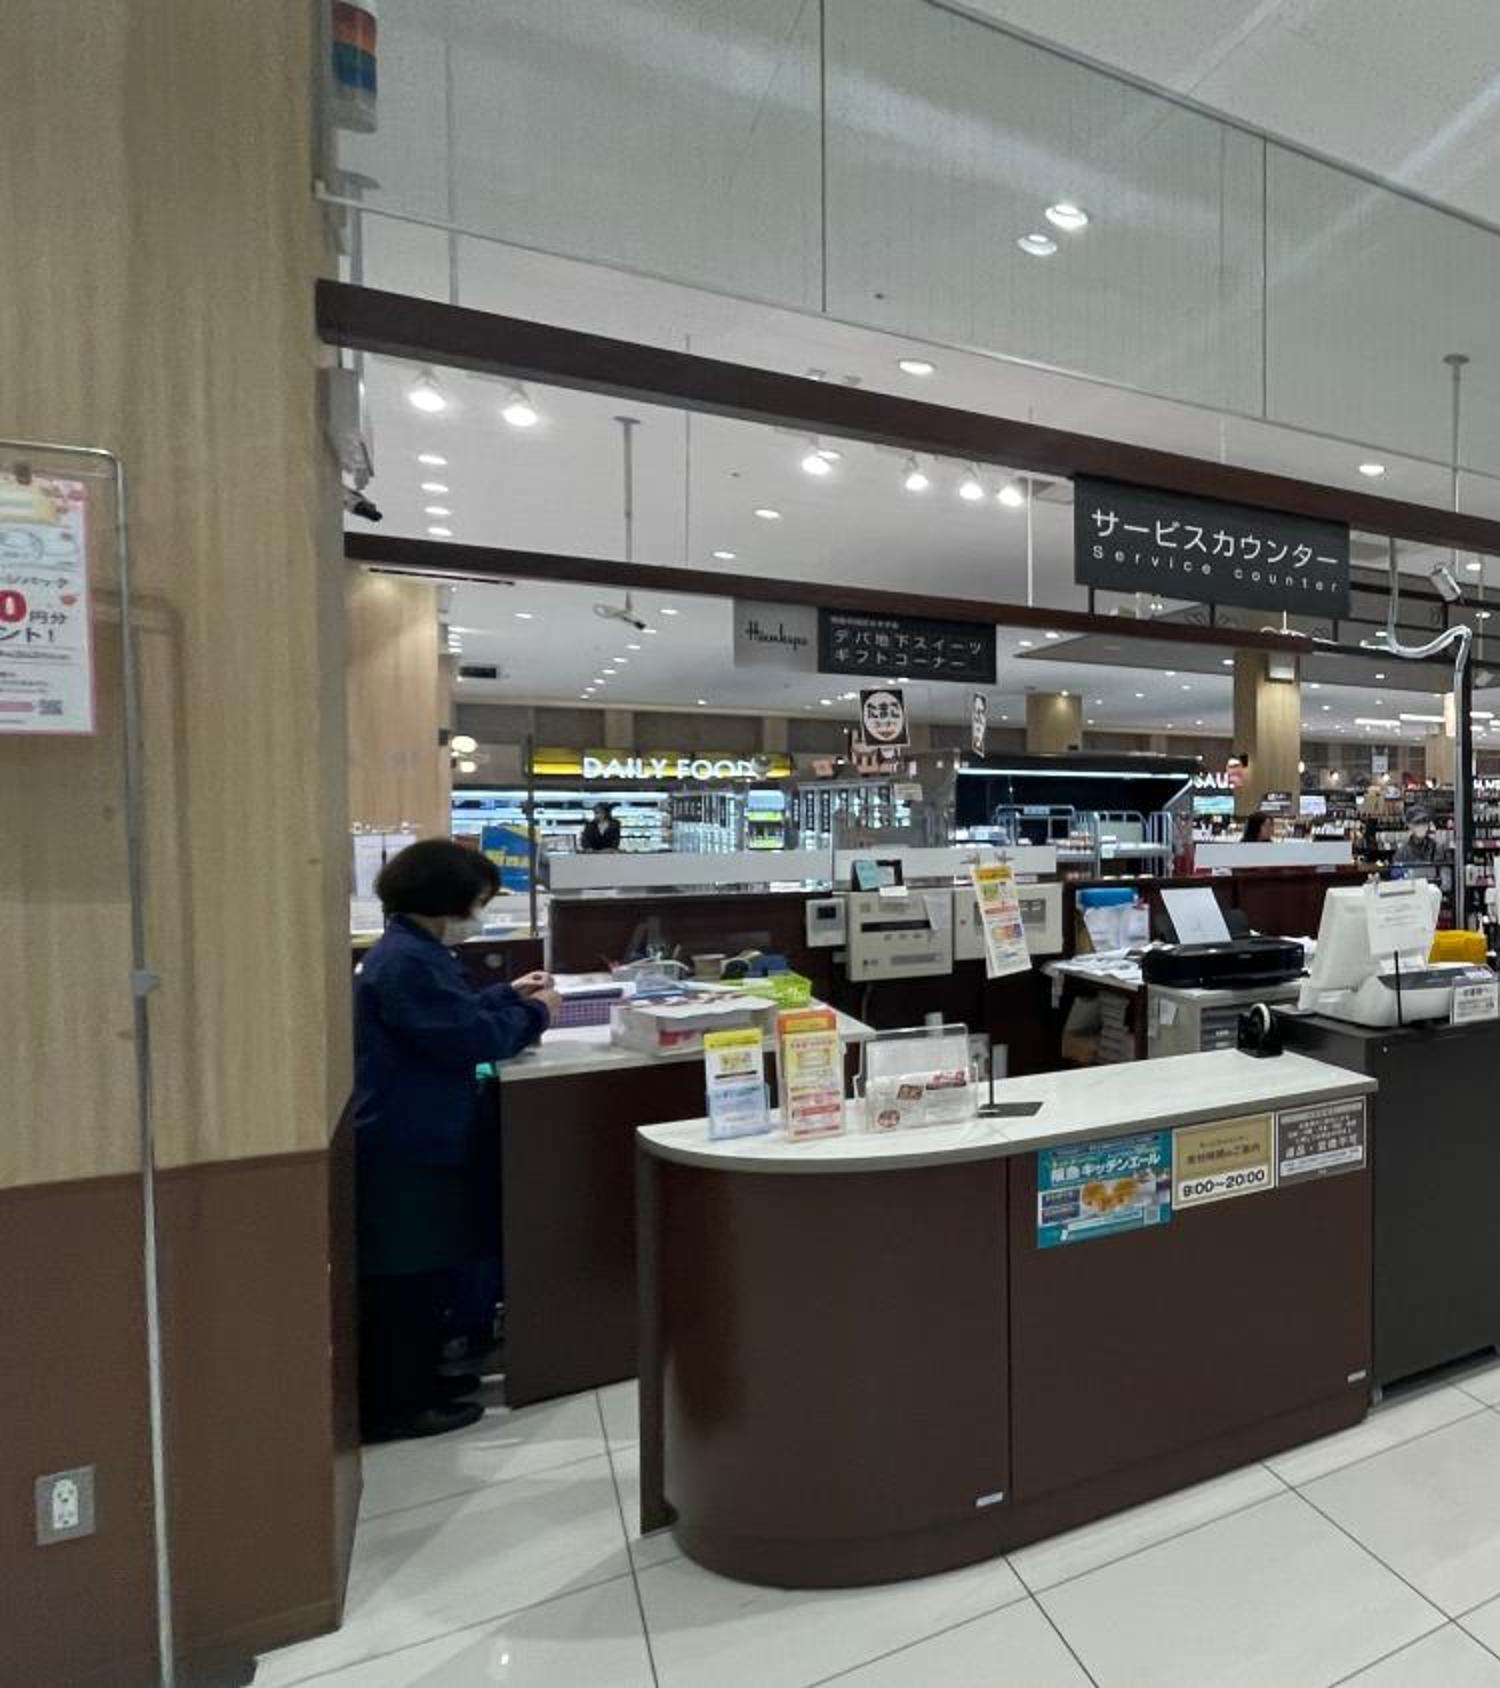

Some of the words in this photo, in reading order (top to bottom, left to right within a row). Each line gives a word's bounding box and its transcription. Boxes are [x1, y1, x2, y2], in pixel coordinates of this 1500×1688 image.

[1091, 508, 1339, 567] サービスカウンター
[1092, 545, 1212, 576] Service
[1233, 567, 1338, 593] counter
[834, 628, 982, 655] デパ地下スイーツ
[834, 647, 966, 669] ギフトコーナー
[583, 757, 667, 780] DAILY
[676, 758, 759, 781] FOOD
